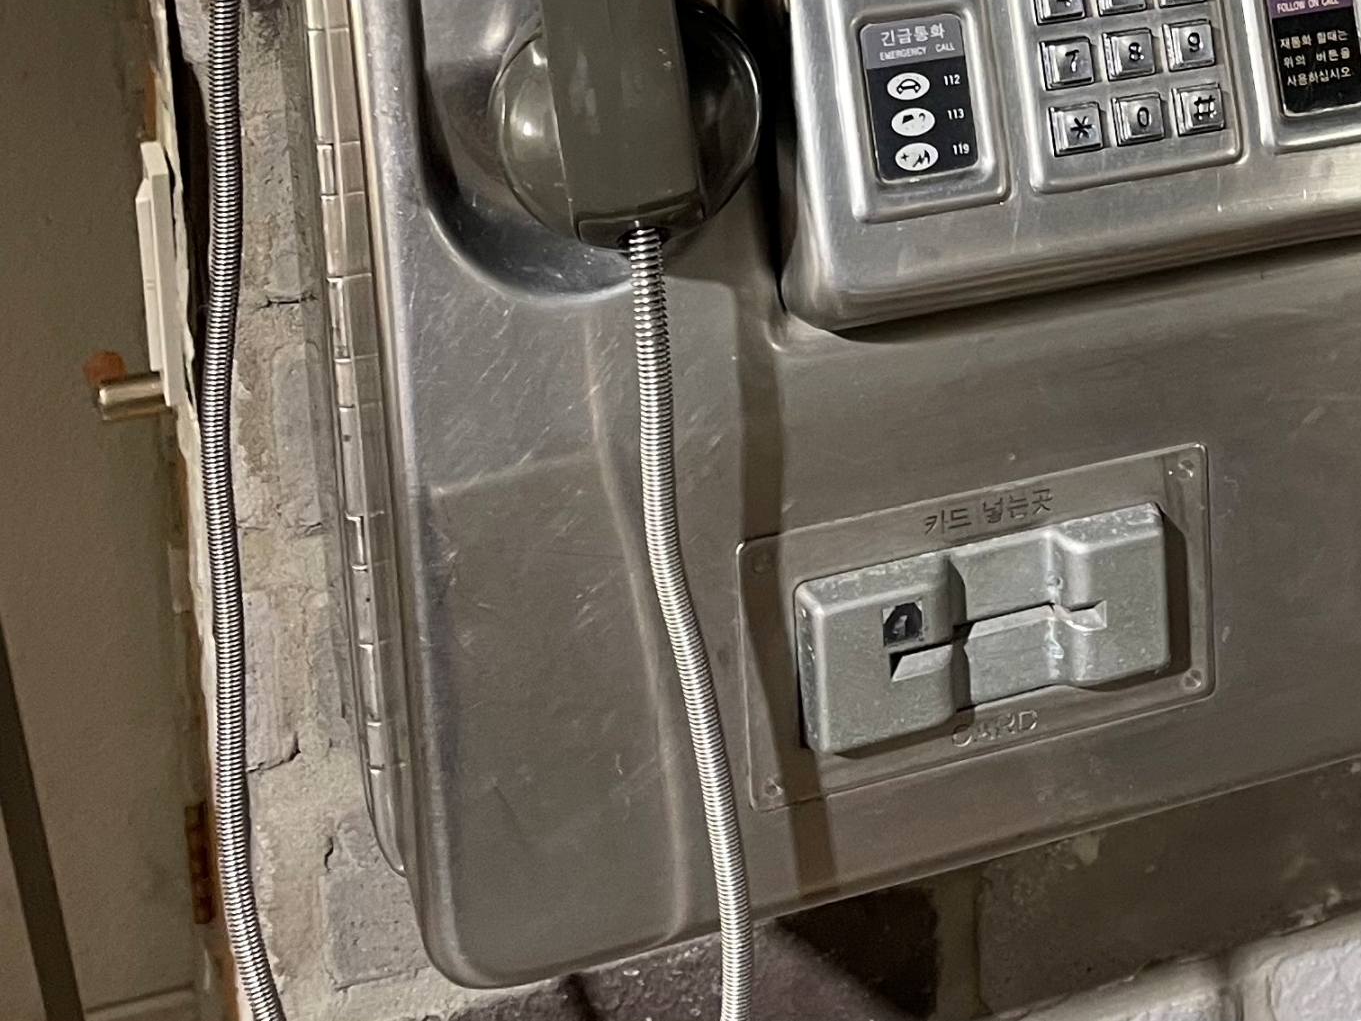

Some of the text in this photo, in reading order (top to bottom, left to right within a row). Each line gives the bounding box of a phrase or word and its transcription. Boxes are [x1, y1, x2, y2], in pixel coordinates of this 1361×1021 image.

[1276, 0, 1306, 14] FOLLOW
[880, 22, 946, 47] 긴급통화
[879, 41, 956, 61] EMERGENCY CALL
[1065, 32, 1203, 73] 7 8 9
[943, 74, 961, 86] 112
[1287, 67, 1351, 87] 사용하십시오
[947, 108, 965, 120] 113
[1136, 106, 1151, 128] 0
[952, 142, 970, 155] 119
[925, 508, 971, 535] 카드
[951, 709, 1038, 747] CARD
